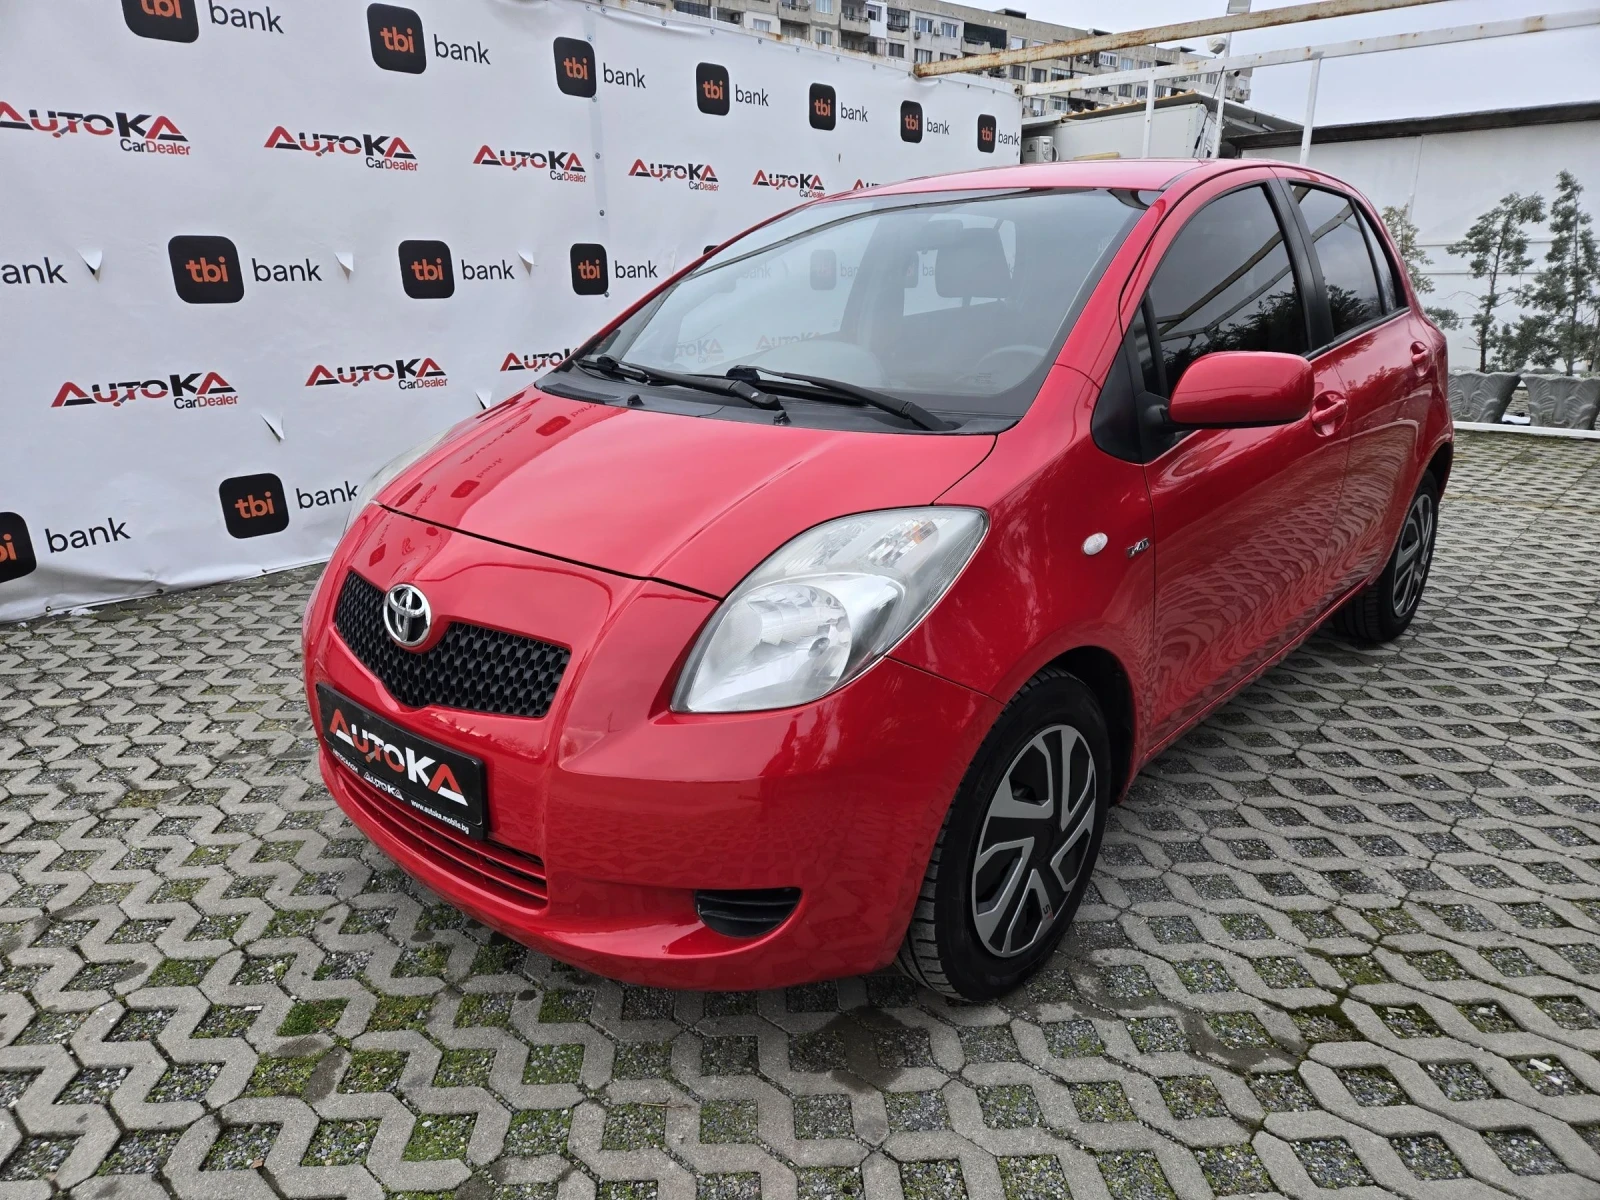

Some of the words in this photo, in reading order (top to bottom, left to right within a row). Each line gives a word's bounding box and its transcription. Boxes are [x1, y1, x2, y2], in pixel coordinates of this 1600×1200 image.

[208, 0, 284, 34] bank
[381, 27, 414, 53] tbi
[434, 34, 491, 65] bank
[564, 58, 588, 81] tbi
[603, 63, 646, 88] bank
[703, 81, 723, 100] tbi
[735, 84, 769, 107] bank
[0, 102, 188, 141] AUTOKA
[814, 99, 831, 117] tbi
[840, 102, 868, 123] bank
[904, 116, 919, 131] tbi
[926, 117, 950, 136] bank
[981, 127, 993, 142] tbi
[998, 130, 1020, 147] bank
[120, 138, 190, 156] CarDealer
[264, 126, 416, 160] AUTOKA
[366, 156, 418, 172] CarDealer
[473, 145, 585, 172] AUTOKA
[628, 158, 719, 182] AUTOKA
[550, 170, 586, 183] CarDealer
[688, 180, 719, 192] CarDealer
[753, 169, 825, 190] AUTOKA
[0, 257, 68, 284] ank
[185, 256, 229, 283] tbi
[252, 258, 322, 283] bank
[411, 258, 443, 281] tbi
[461, 259, 515, 280] bank
[577, 261, 600, 279] tbi
[615, 260, 658, 279] bank
[305, 358, 446, 387] AUTOKA
[500, 349, 578, 372] AUTO
[51, 372, 236, 407] AUTOKA
[398, 376, 448, 391] CarDealer
[173, 394, 239, 410] CarDealer
[234, 491, 275, 519] tbi
[296, 480, 358, 509] bank
[45, 517, 132, 553] bank
[329, 708, 469, 806] AUTOKA
